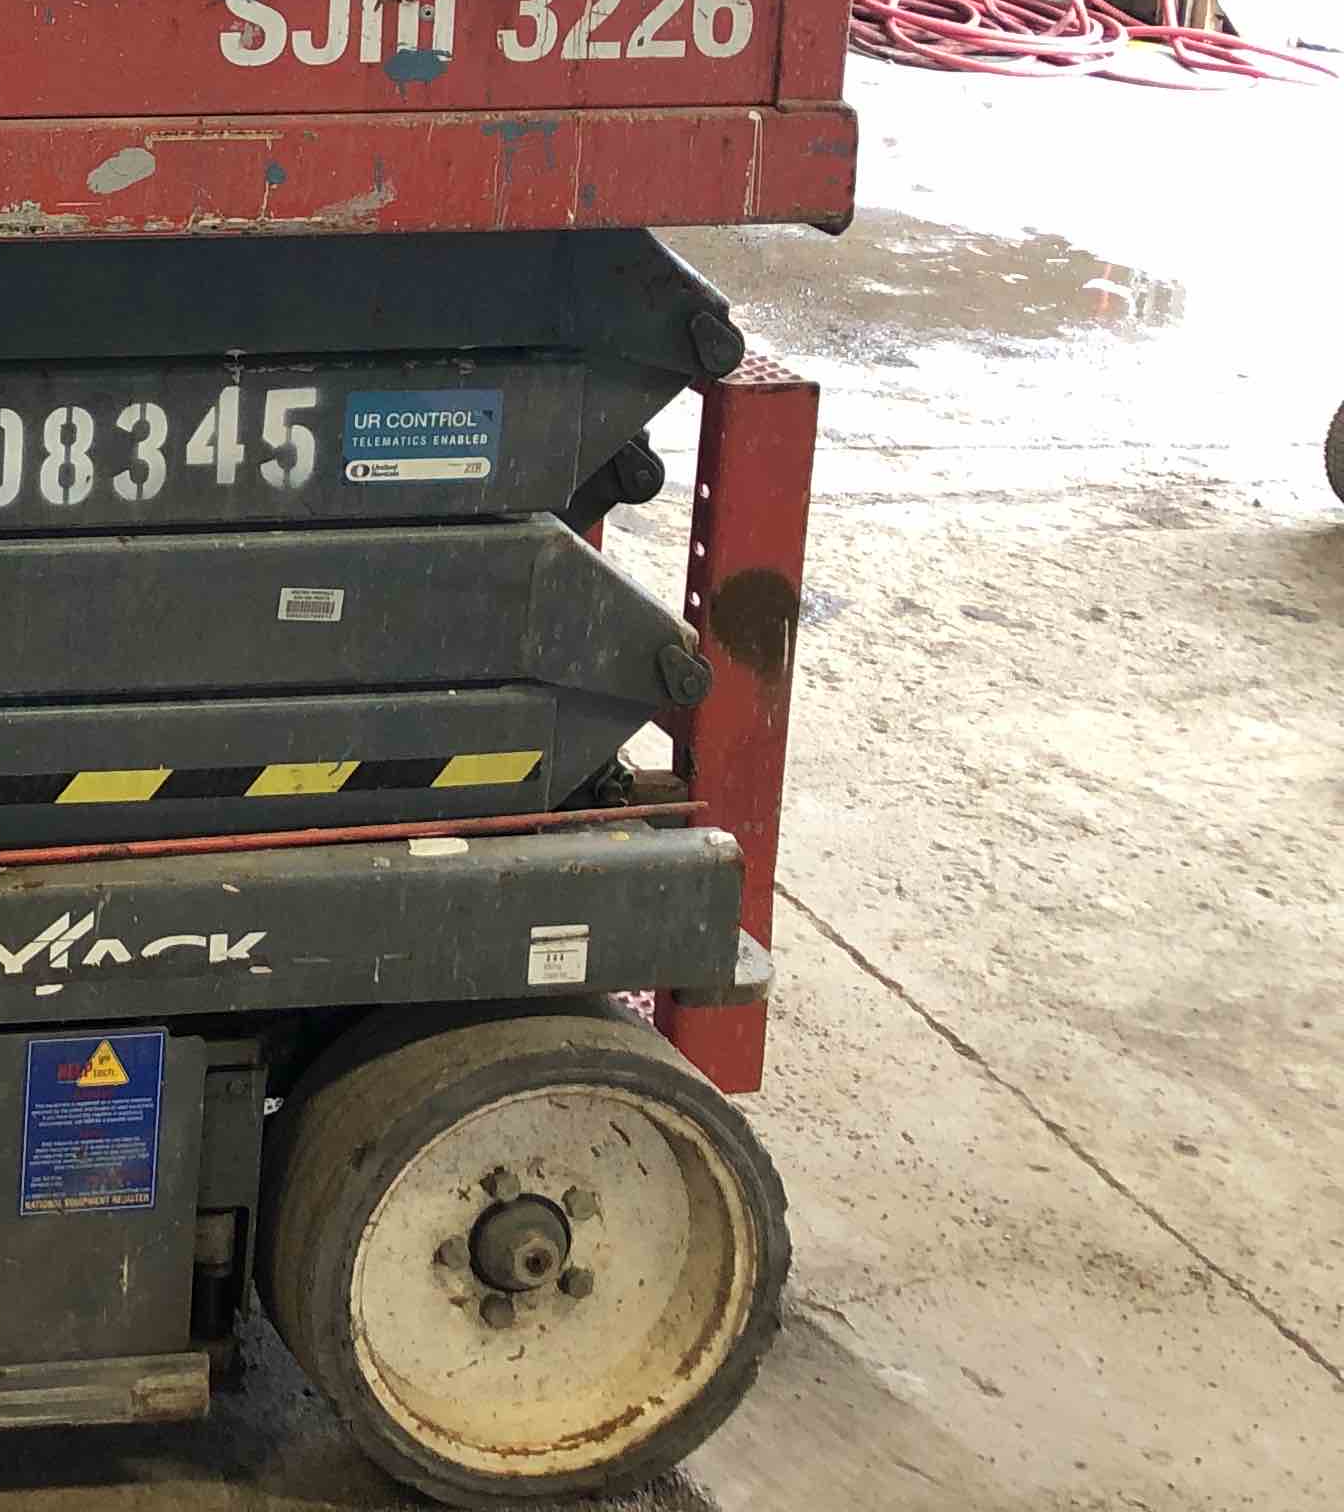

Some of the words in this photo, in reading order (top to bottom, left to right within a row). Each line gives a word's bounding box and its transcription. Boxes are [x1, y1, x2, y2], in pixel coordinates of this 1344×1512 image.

[354, 413, 381, 429] UR
[386, 410, 477, 428] CONTROL
[352, 435, 427, 447] TELEMATICS
[433, 433, 488, 445] ENABLED
